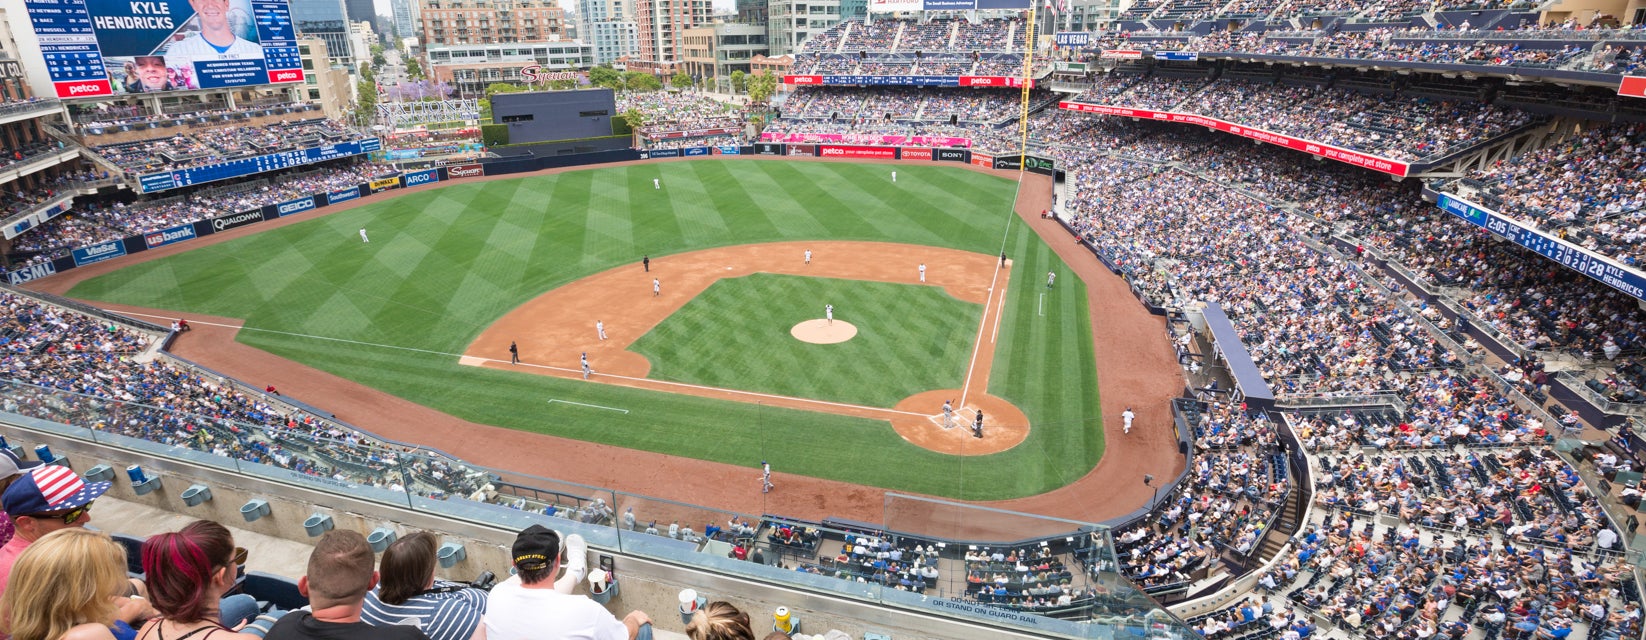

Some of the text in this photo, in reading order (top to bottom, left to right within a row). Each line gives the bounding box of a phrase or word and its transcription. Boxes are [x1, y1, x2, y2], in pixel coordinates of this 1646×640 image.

[130, 2, 170, 14] KYLE
[94, 16, 174, 29] HENDRICKS
[1058, 34, 1087, 44] LAS VEGAS
[277, 72, 297, 81] petco
[521, 65, 577, 86] Sycuan
[69, 84, 100, 94] petco
[376, 98, 482, 115] NATIONAL
[823, 147, 844, 155] petco
[1306, 143, 1320, 153] petco
[1337, 151, 1364, 164] complete
[1364, 158, 1374, 166] pet
[1376, 161, 1392, 170] store
[451, 167, 480, 176] Sycuan
[407, 174, 429, 184] ARCO
[330, 192, 355, 201] Southwest
[280, 200, 313, 213] GEICO
[214, 211, 261, 230] QUALCOMM
[1488, 217, 1507, 234] 2:05
[1510, 225, 1520, 234] CHC
[85, 243, 117, 255] ViaSat
[1555, 251, 1563, 261] 2
[1565, 255, 1586, 271] 0 2 0
[1588, 261, 1605, 276] 28
[11, 262, 54, 285] ASML
[1606, 265, 1624, 279] KYLE
[1602, 274, 1644, 297] HENDRICKS
[946, 602, 972, 612] STAND
[989, 611, 1017, 620] GUARD
